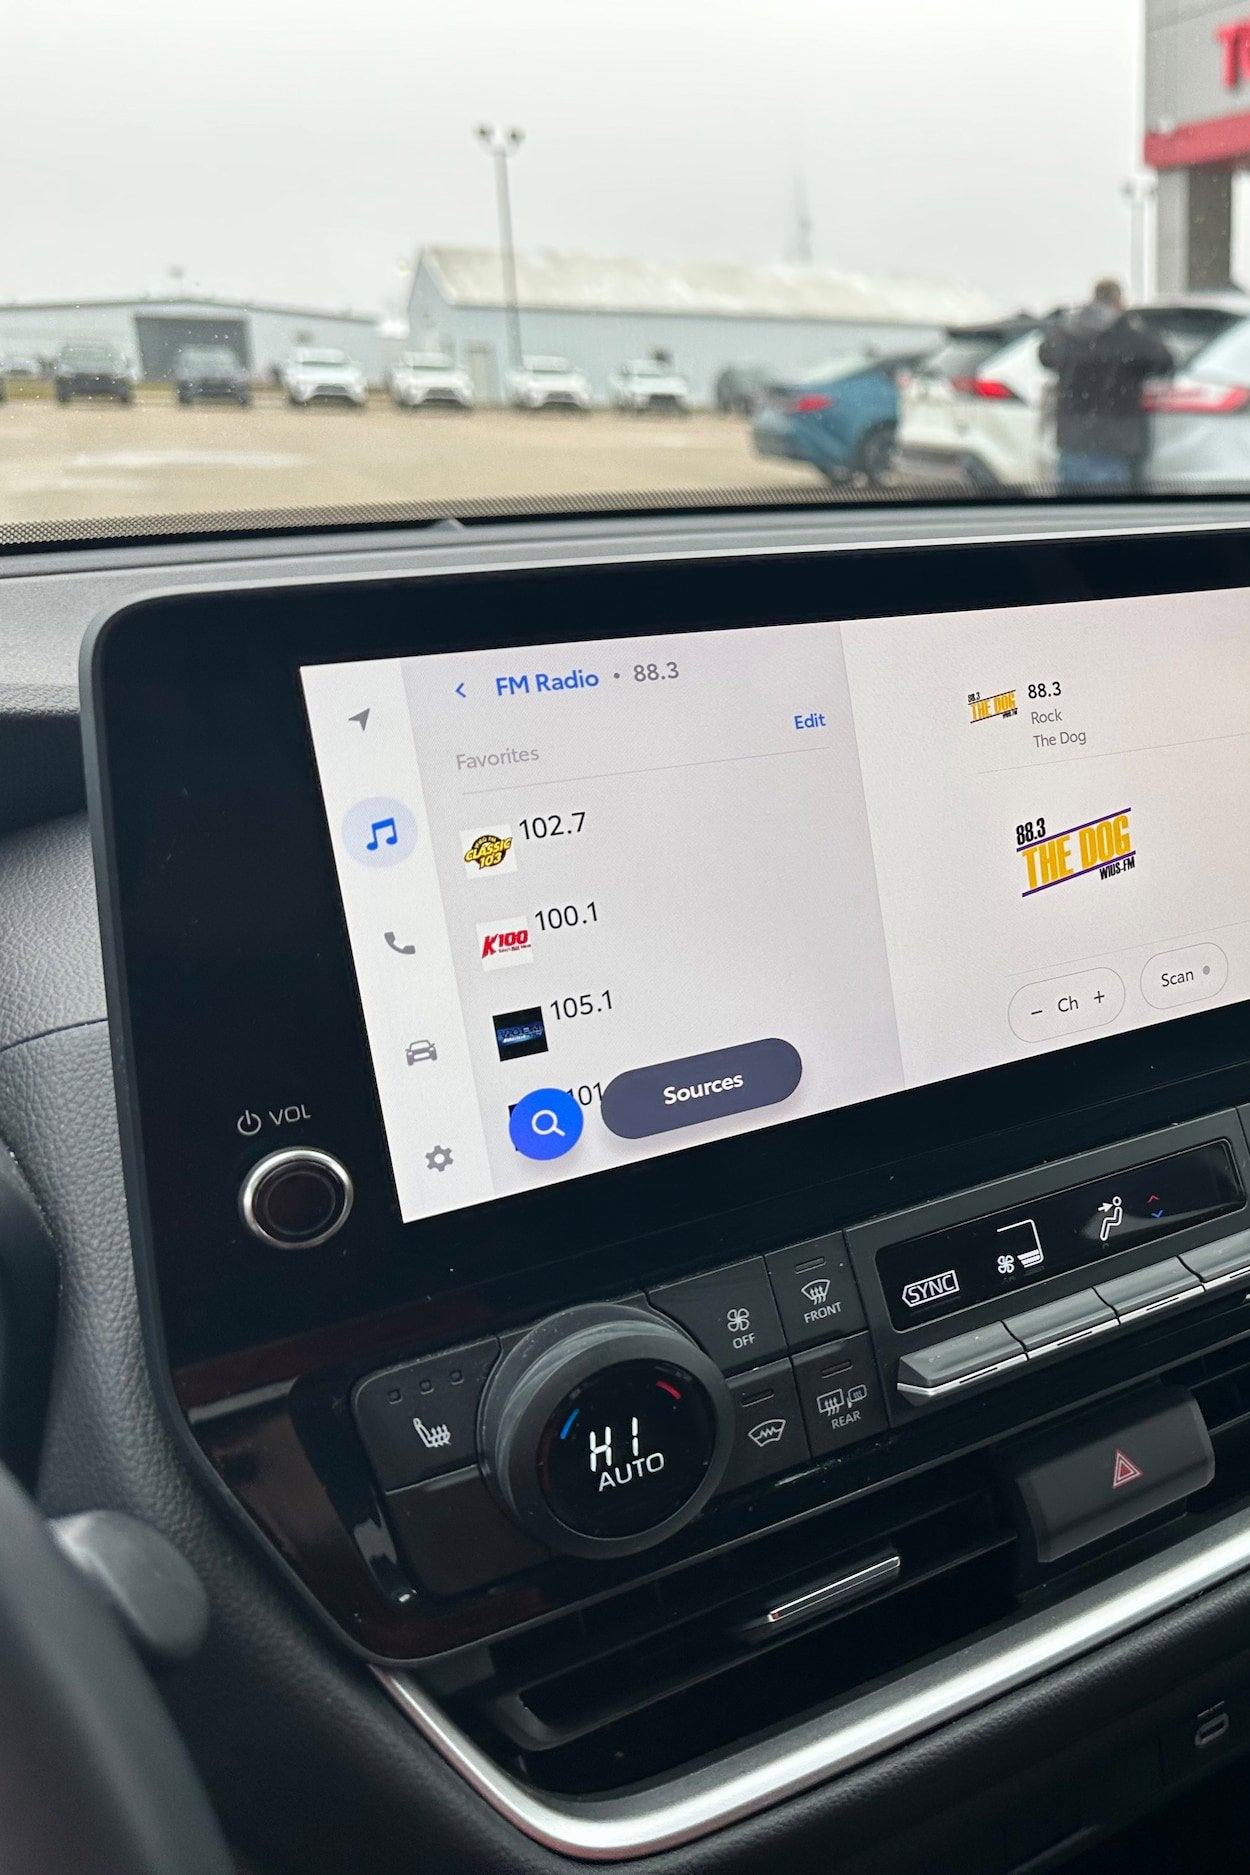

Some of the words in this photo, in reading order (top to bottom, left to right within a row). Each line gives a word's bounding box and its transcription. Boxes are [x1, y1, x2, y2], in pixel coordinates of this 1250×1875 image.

[495, 674, 531, 697] FM
[535, 669, 600, 692] Radio
[633, 661, 680, 683] 88.3
[1027, 681, 1062, 699] 88.3
[793, 712, 826, 730] Edit
[970, 700, 991, 720] THE
[1030, 708, 1063, 725] Rock
[1033, 734, 1057, 748] The
[1059, 731, 1087, 746] Dog
[456, 748, 540, 770] Favorites
[519, 811, 586, 840] 102.7
[1016, 817, 1046, 845] 88.3
[464, 837, 512, 862] CLASSIC
[479, 852, 503, 868] 103
[1022, 834, 1074, 889] THE
[1078, 814, 1131, 869] DOG
[534, 901, 598, 931] 100.1
[481, 929, 529, 959] K100
[1161, 970, 1194, 987] Scan
[550, 989, 612, 1020] 105.1
[1057, 995, 1079, 1012] Ch
[663, 1074, 744, 1105] Sources
[268, 1104, 311, 1125] VOL
[907, 1274, 955, 1303] SYNC
[803, 1301, 842, 1323] FRONT
[732, 1332, 755, 1349] OFF
[831, 1410, 861, 1429] REAR
[599, 1452, 664, 1492] AUTO
